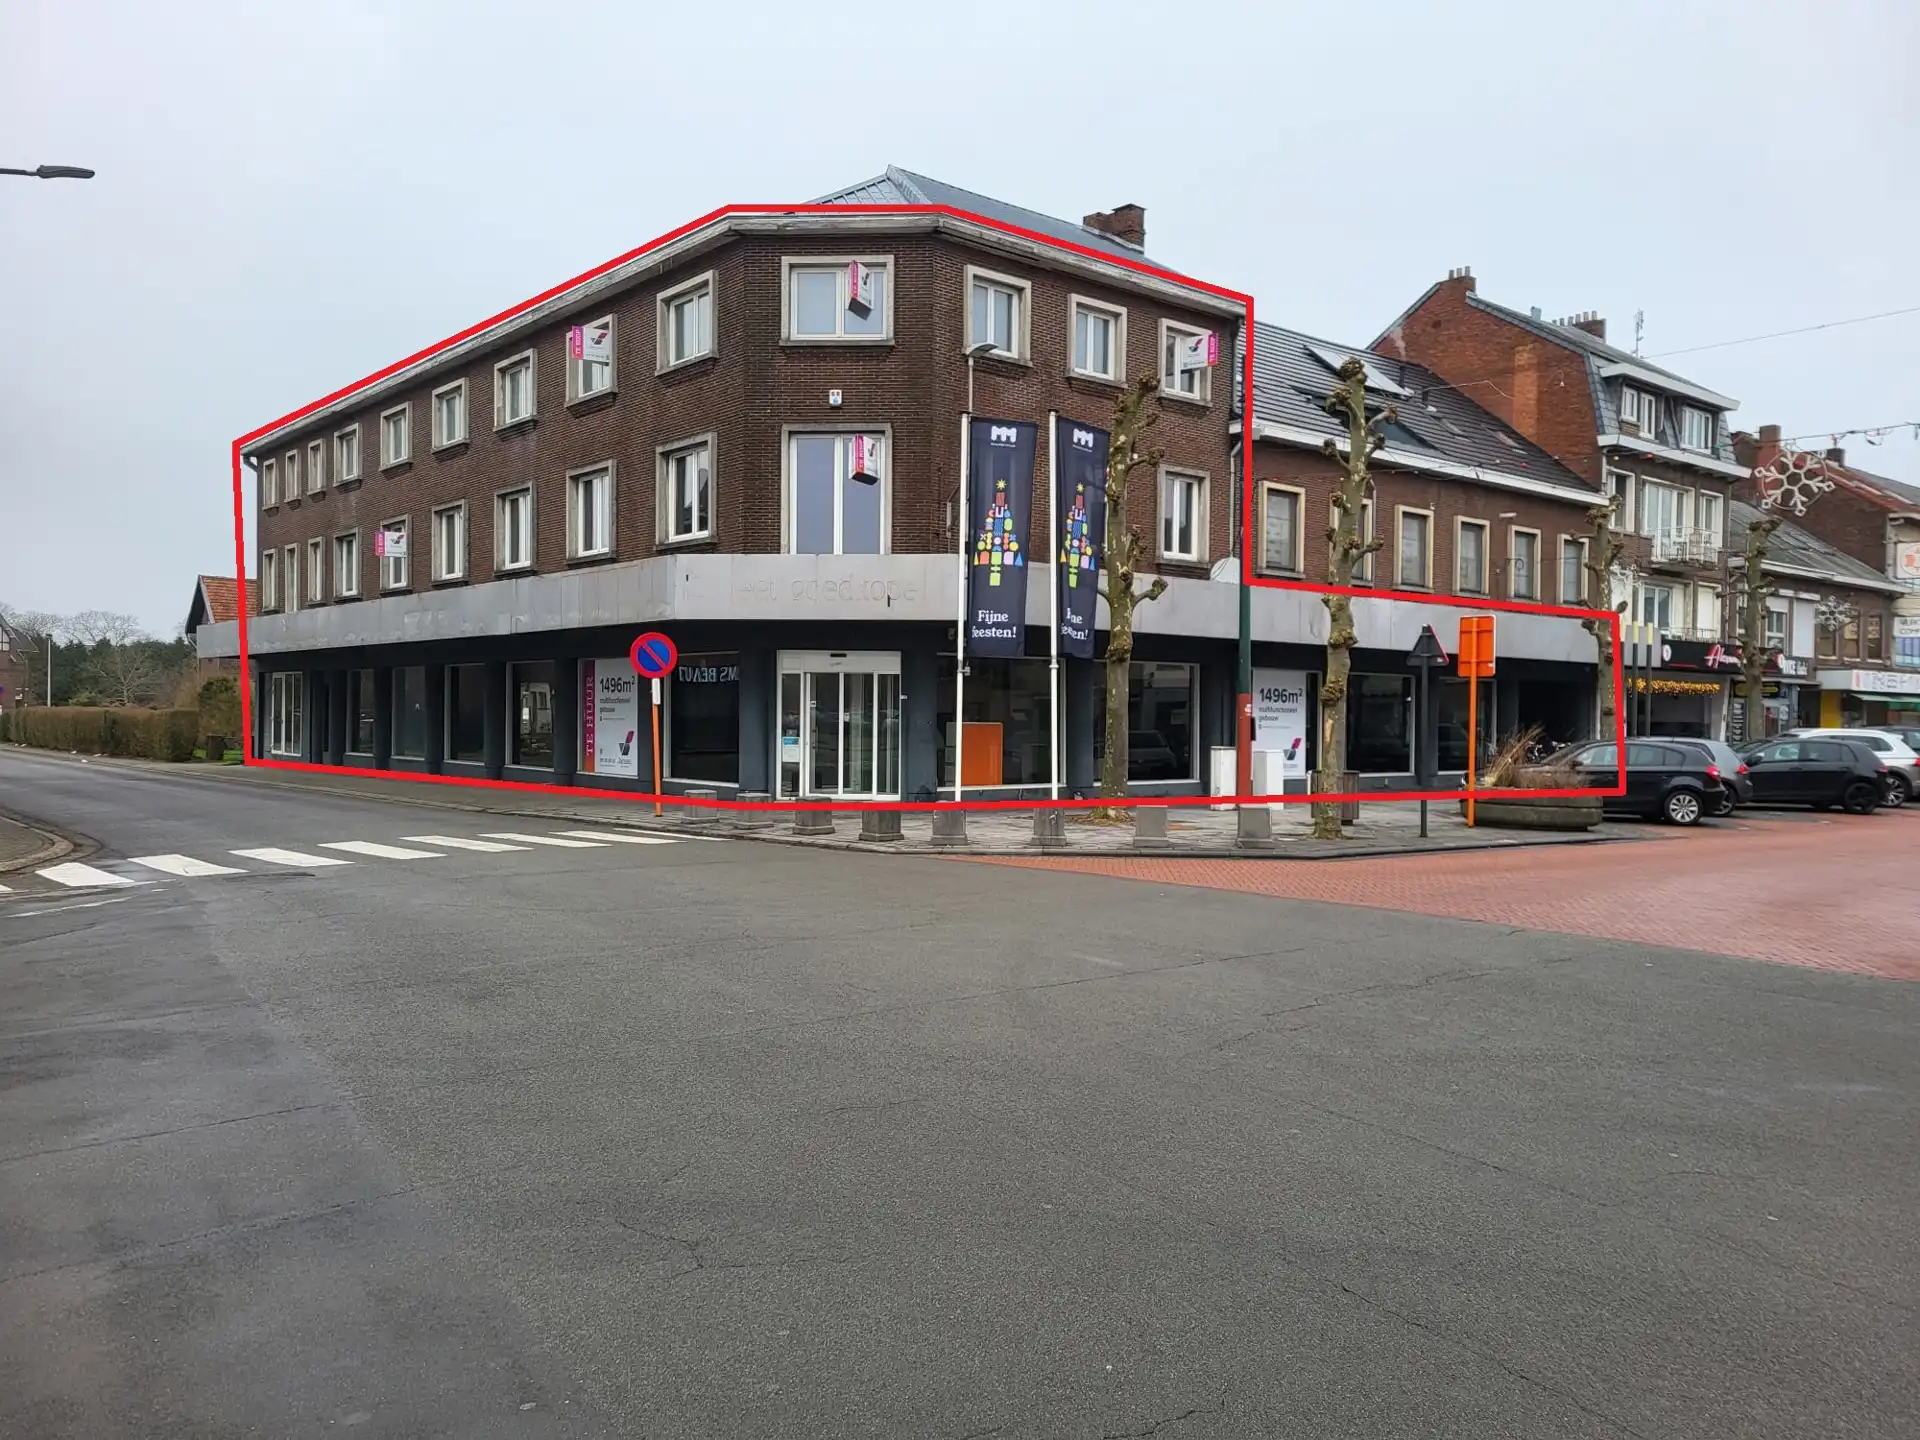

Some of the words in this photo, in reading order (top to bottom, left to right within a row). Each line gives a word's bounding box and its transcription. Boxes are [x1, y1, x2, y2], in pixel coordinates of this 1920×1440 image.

[977, 610, 1009, 625] Fijne
[586, 676, 594, 728] HUUR
[1259, 688, 1303, 704] 1496m²
[586, 733, 594, 756] TE
